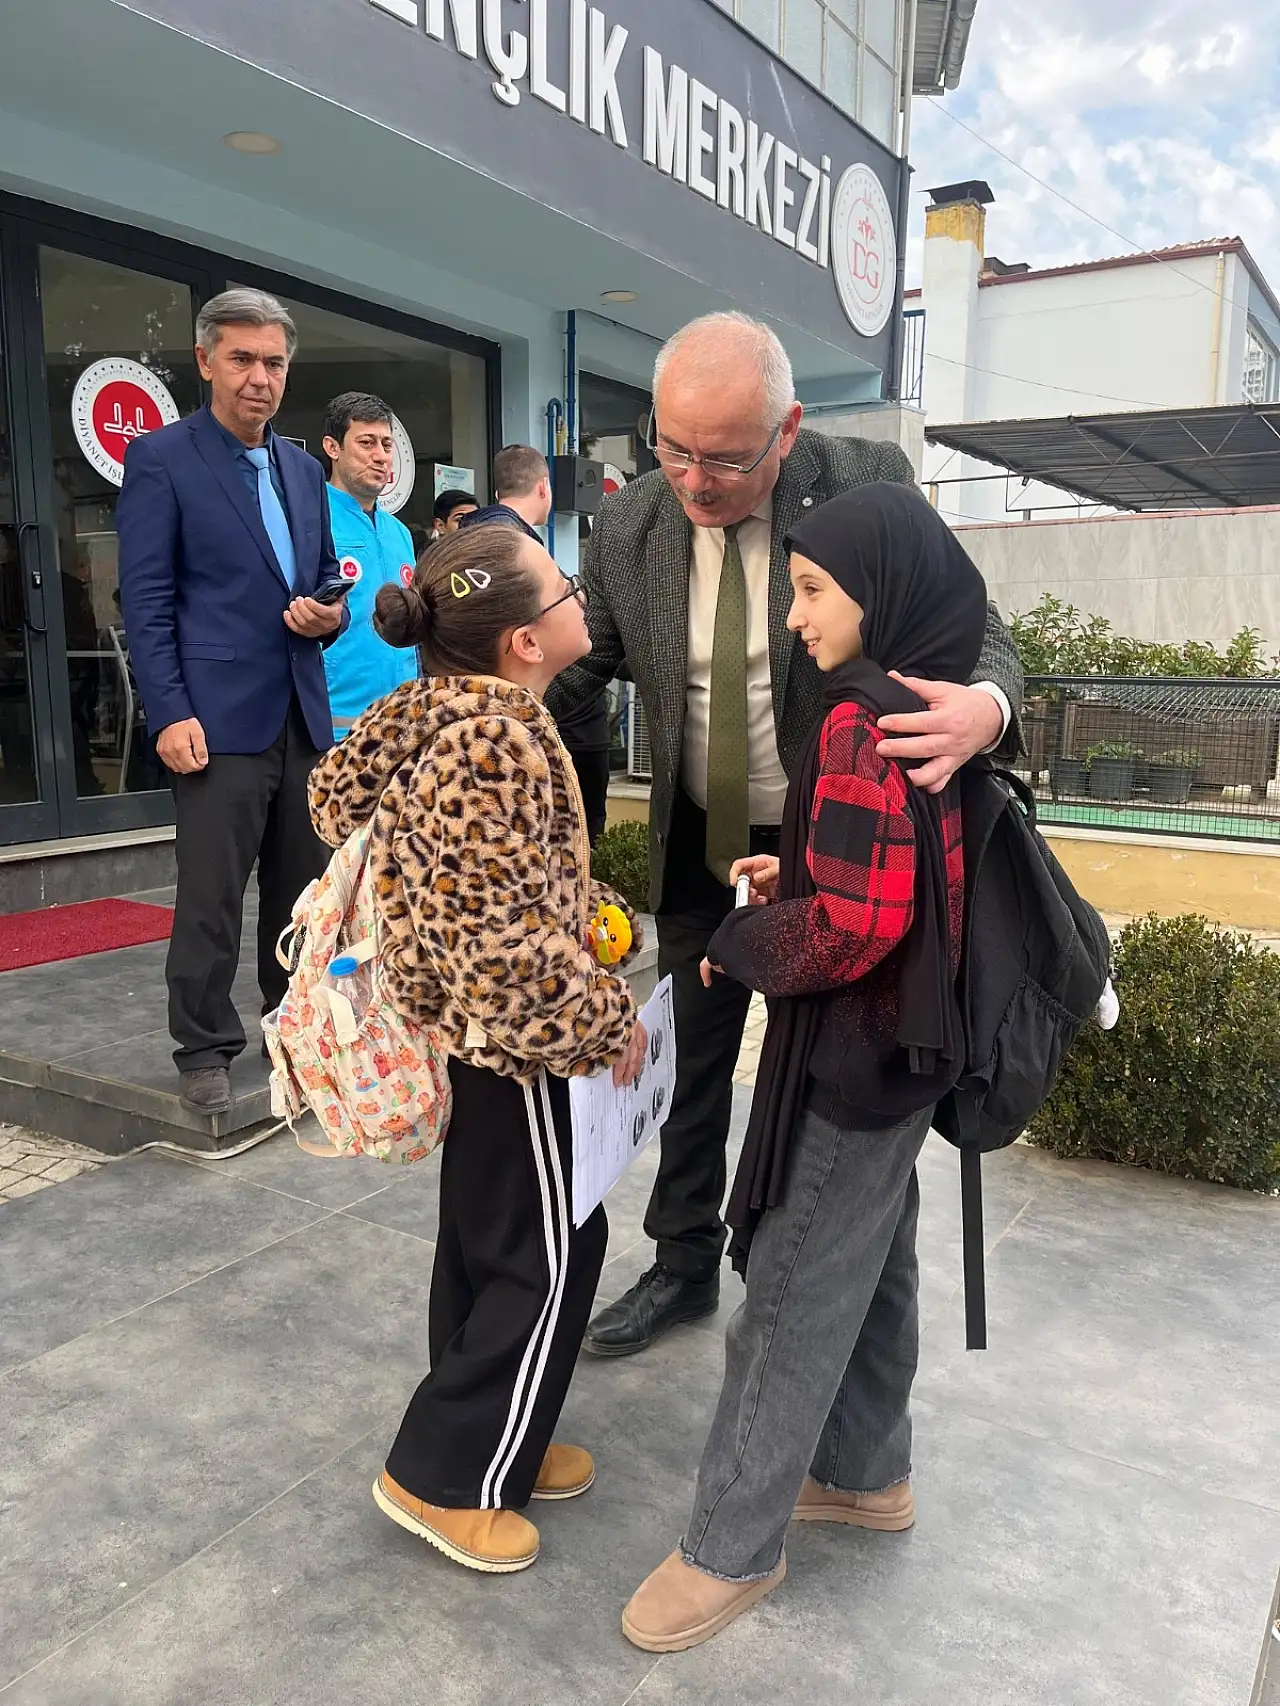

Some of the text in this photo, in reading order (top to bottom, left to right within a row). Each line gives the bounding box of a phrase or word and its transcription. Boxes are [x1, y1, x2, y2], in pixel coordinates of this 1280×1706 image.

[643, 45, 832, 269] MERKEZİ
[852, 239, 880, 290] DG
[78, 417, 109, 468] DİYANET
